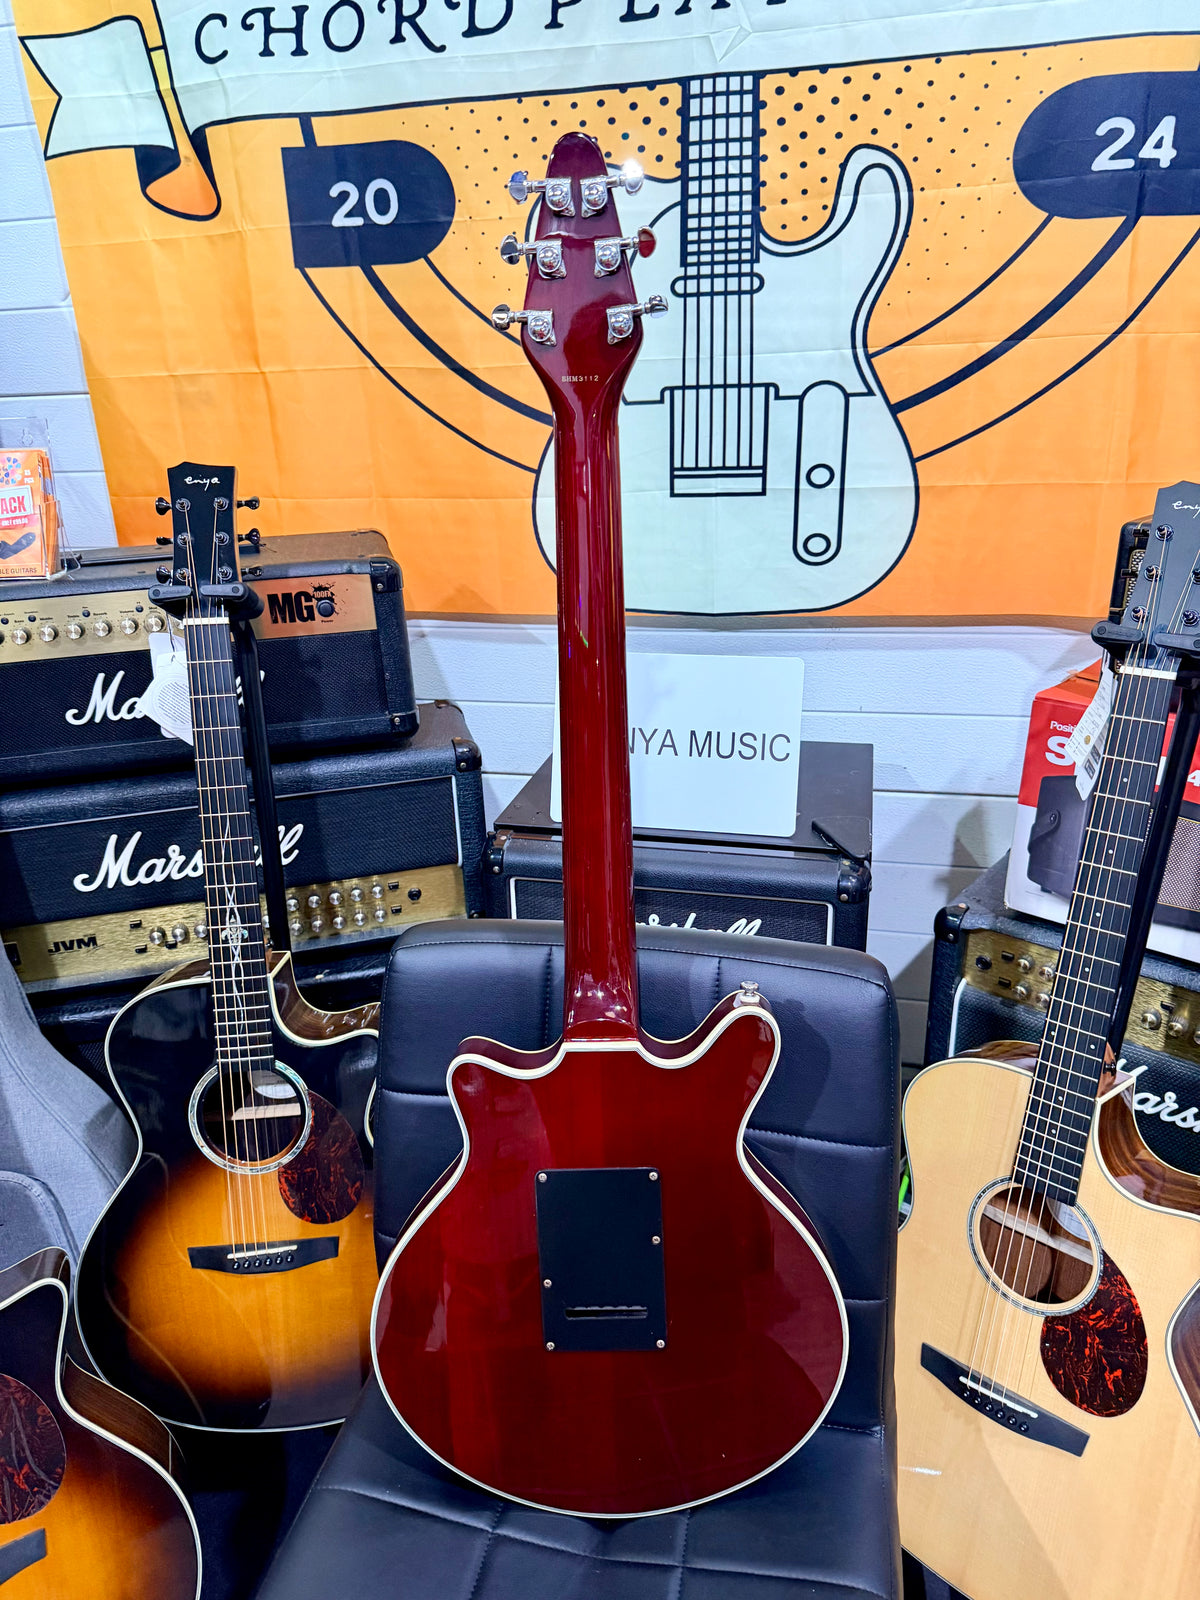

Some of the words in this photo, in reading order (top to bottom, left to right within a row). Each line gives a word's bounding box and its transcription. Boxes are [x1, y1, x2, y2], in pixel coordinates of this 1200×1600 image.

[195, 0, 513, 64] CHORD
[1091, 116, 1177, 171] 24
[329, 178, 399, 227] 20
[184, 475, 220, 492] enya
[0, 495, 27, 515] ACK
[1172, 500, 1200, 519] eny
[267, 591, 316, 624] MG
[629, 727, 679, 757] YA
[688, 729, 791, 762] MUSIC
[48, 936, 98, 953] JVM
